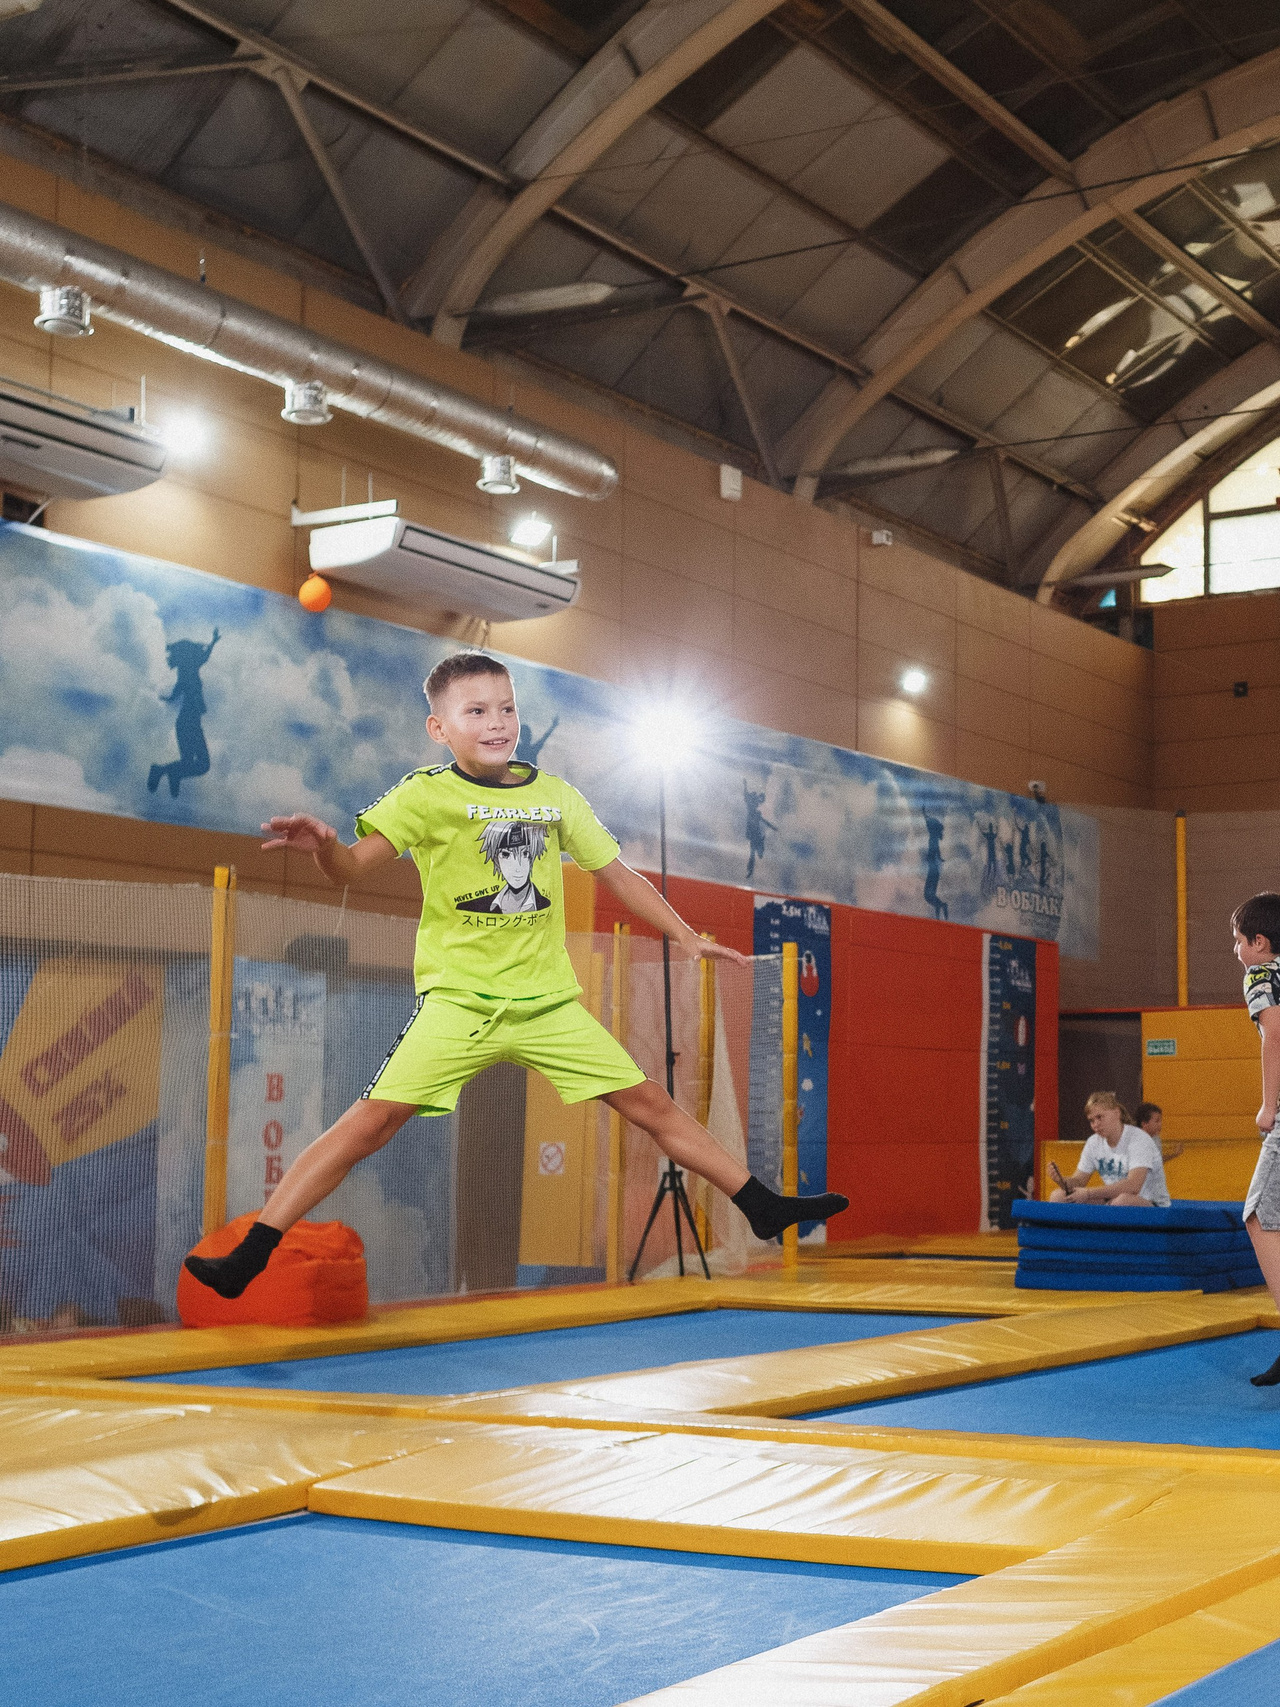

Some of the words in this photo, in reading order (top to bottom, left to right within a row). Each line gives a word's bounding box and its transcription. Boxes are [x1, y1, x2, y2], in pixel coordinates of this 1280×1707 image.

[466, 804, 563, 822] FEARLESS
[454, 892, 474, 904] NEVER
[491, 884, 501, 894] UP
[996, 886, 1007, 908] В
